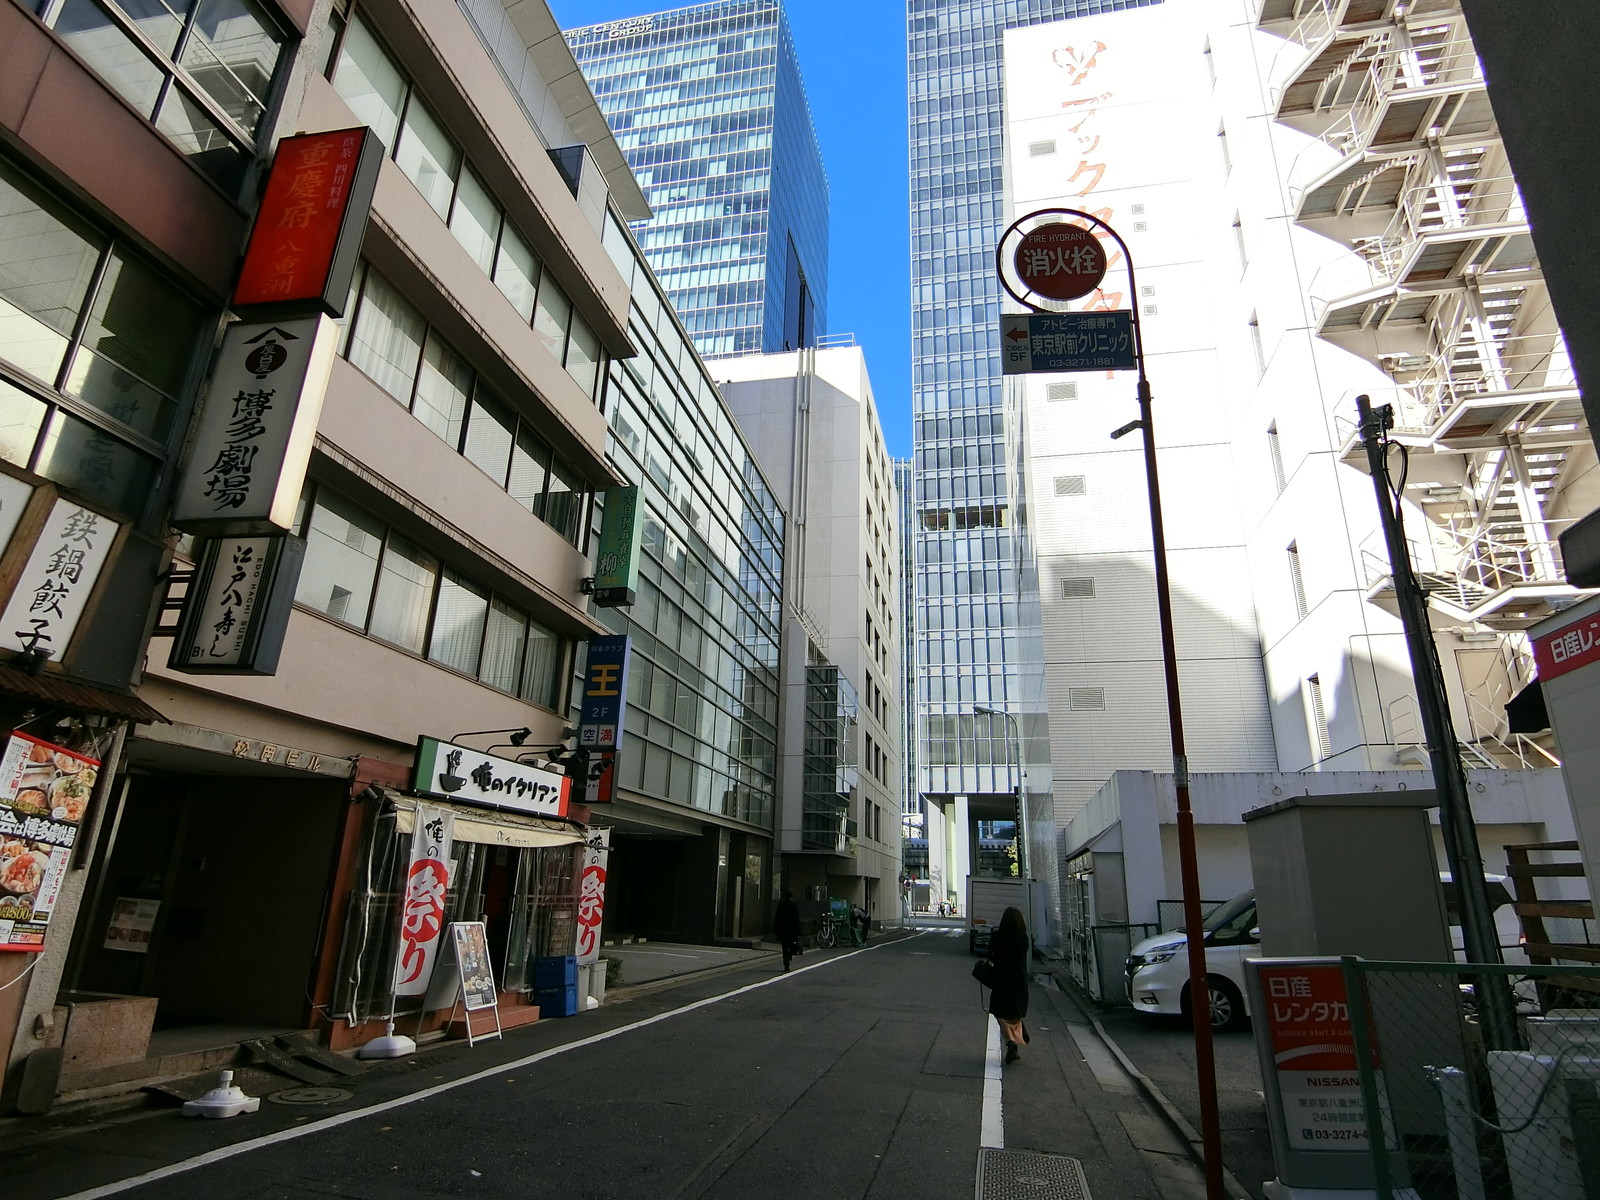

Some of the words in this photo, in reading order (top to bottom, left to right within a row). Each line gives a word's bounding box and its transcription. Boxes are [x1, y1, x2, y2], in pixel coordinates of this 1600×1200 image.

[592, 17, 653, 34] CENTURY
[609, 23, 653, 39] GROUP
[277, 142, 334, 230] 重慶府
[1028, 233, 1047, 244] FIRE
[1049, 232, 1087, 243] HYDRANT
[262, 240, 302, 294] 八重洲
[1023, 245, 1099, 277] 消火栓
[1041, 317, 1116, 331] アトピー治療専門
[1006, 344, 1030, 352] このビル
[1031, 331, 1129, 356] 東京駅前クリニック
[1010, 352, 1027, 362] 5F
[1049, 357, 1115, 368] 03-3271-1881
[203, 389, 276, 511] 博多劇場
[253, 558, 264, 578] EDO
[600, 552, 618, 577] 柳
[15, 508, 98, 655] 鉄鍋餃子
[209, 545, 253, 658] 江戸八寿し
[243, 583, 257, 615] HACHI
[234, 620, 247, 651] SUSHI
[191, 646, 205, 658] B1
[586, 664, 620, 696] 王
[592, 707, 609, 718] 2F
[582, 728, 595, 742] 空
[599, 728, 613, 742] 満
[233, 740, 321, 772] 松岡ビル
[471, 761, 559, 804] 俺のイタリアン
[0, 808, 77, 843] 会は博多劇場
[398, 817, 446, 985] 俺の祭り
[1268, 976, 1312, 998] 日産
[1307, 1077, 1360, 1087] NISSAN
